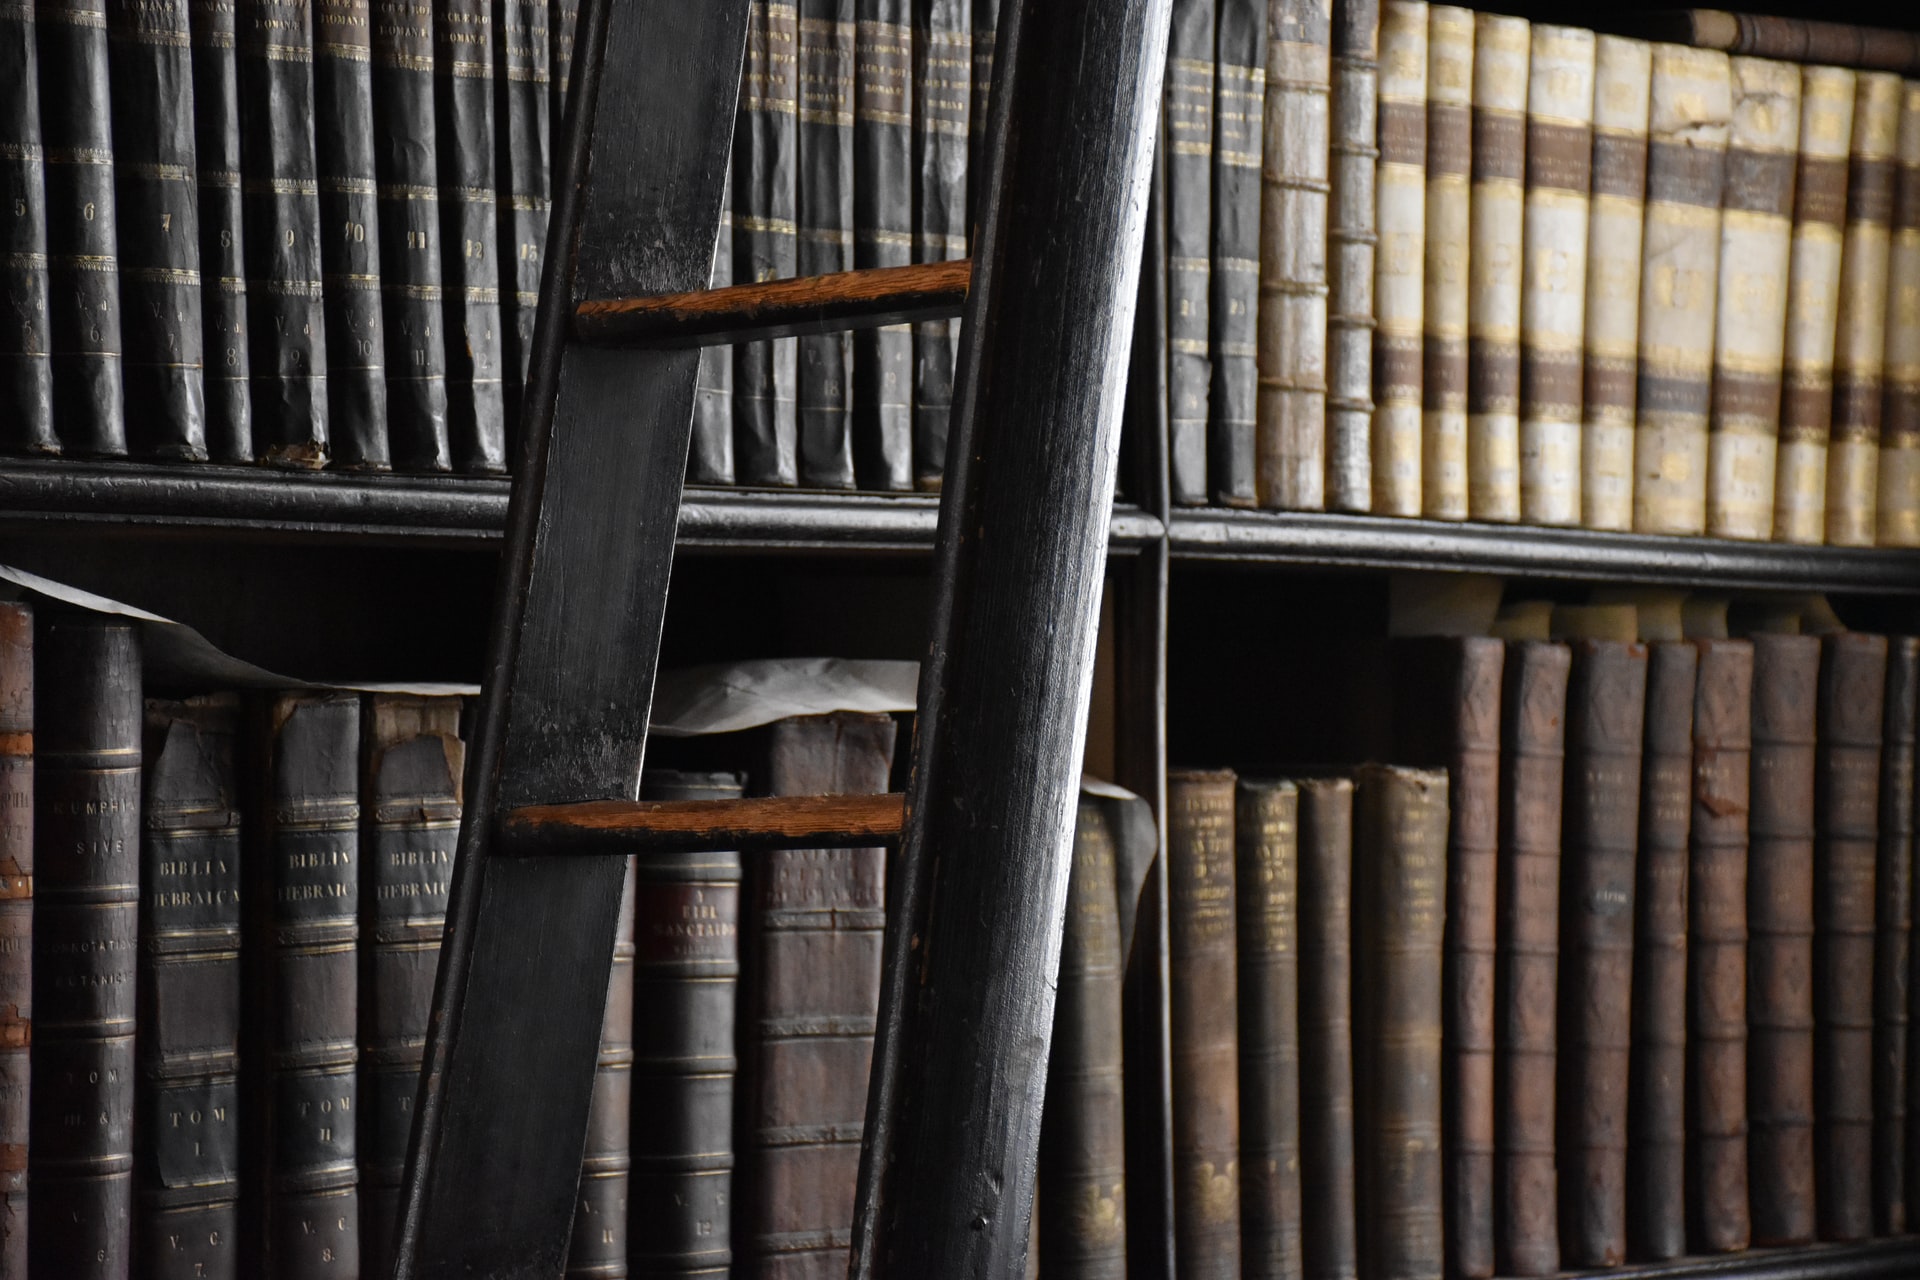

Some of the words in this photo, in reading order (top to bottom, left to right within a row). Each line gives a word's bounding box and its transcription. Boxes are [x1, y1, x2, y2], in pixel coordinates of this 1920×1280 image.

[14, 198, 27, 217] 5
[83, 202, 95, 222] 6
[161, 213, 172, 232] 7
[220, 229, 232, 248] 8
[285, 229, 295, 248] 9
[466, 239, 484, 259] 12
[76, 840, 125, 856] SIVE
[160, 859, 227, 876] BIBLIA
[377, 880, 448, 900] HEBRAIC
[168, 1106, 226, 1129] TOM
[169, 1233, 185, 1252] V.
[321, 1246, 336, 1264] 8.
